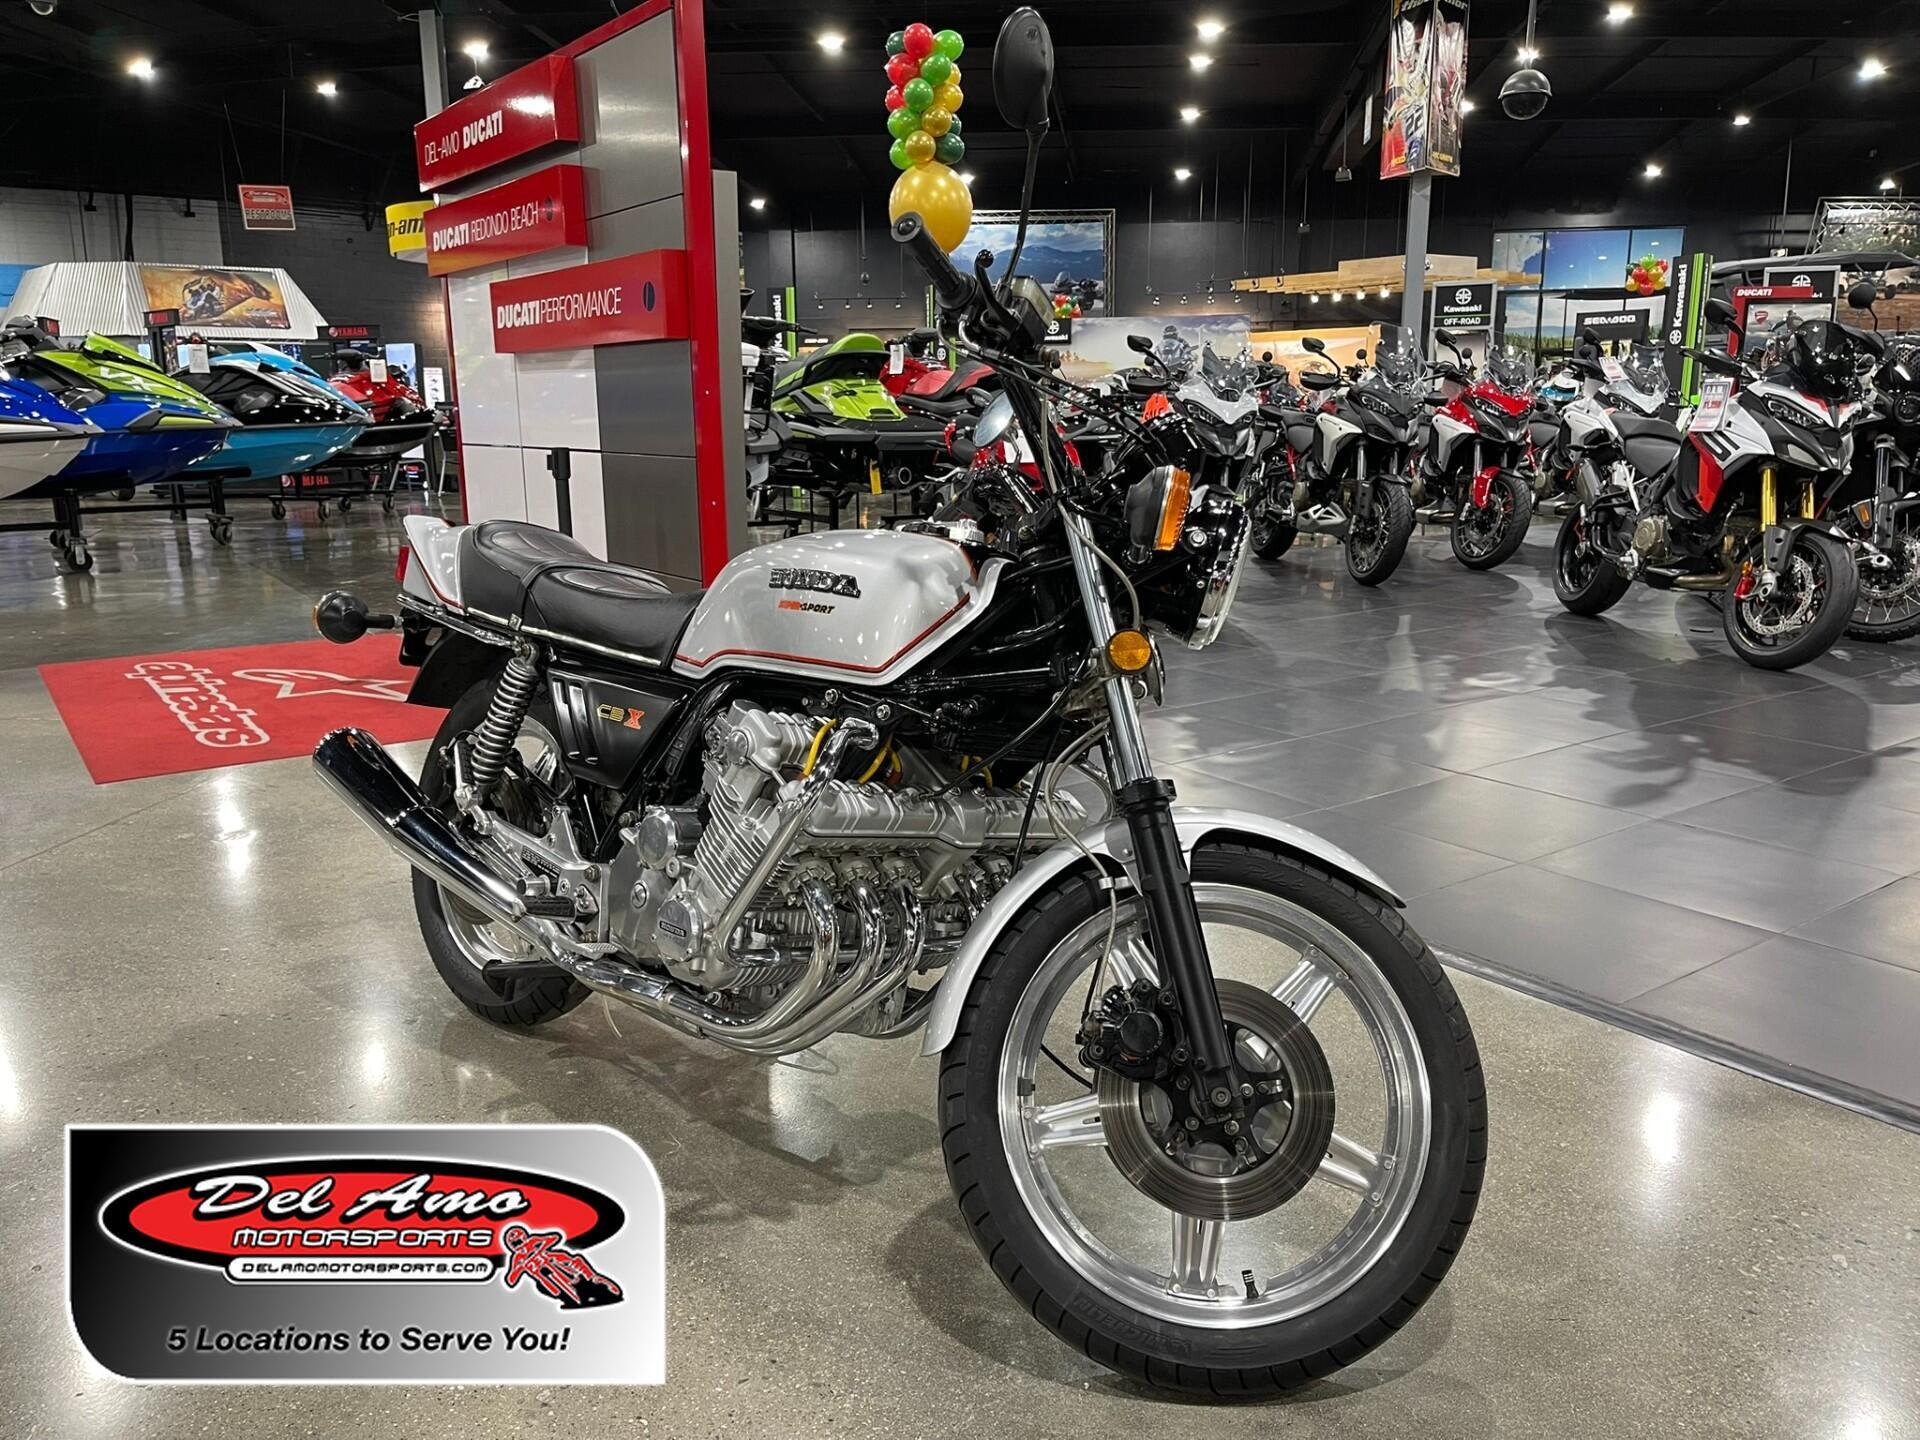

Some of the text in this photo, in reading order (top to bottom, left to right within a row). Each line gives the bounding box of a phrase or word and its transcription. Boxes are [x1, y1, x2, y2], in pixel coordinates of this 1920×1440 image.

[463, 110, 503, 150] DUCATI
[432, 200, 539, 252] DUCATI REDONDO BEACH
[497, 287, 622, 329] DUCATI PERFORMANCE
[1673, 264, 1688, 328] Kawasaki
[1737, 288, 1773, 297] DUCATI
[1443, 304, 1482, 313] Kawasaki
[1443, 317, 1481, 326] OFF-ROAD
[337, 327, 368, 336] YAMAHA
[768, 568, 862, 599] HONDA
